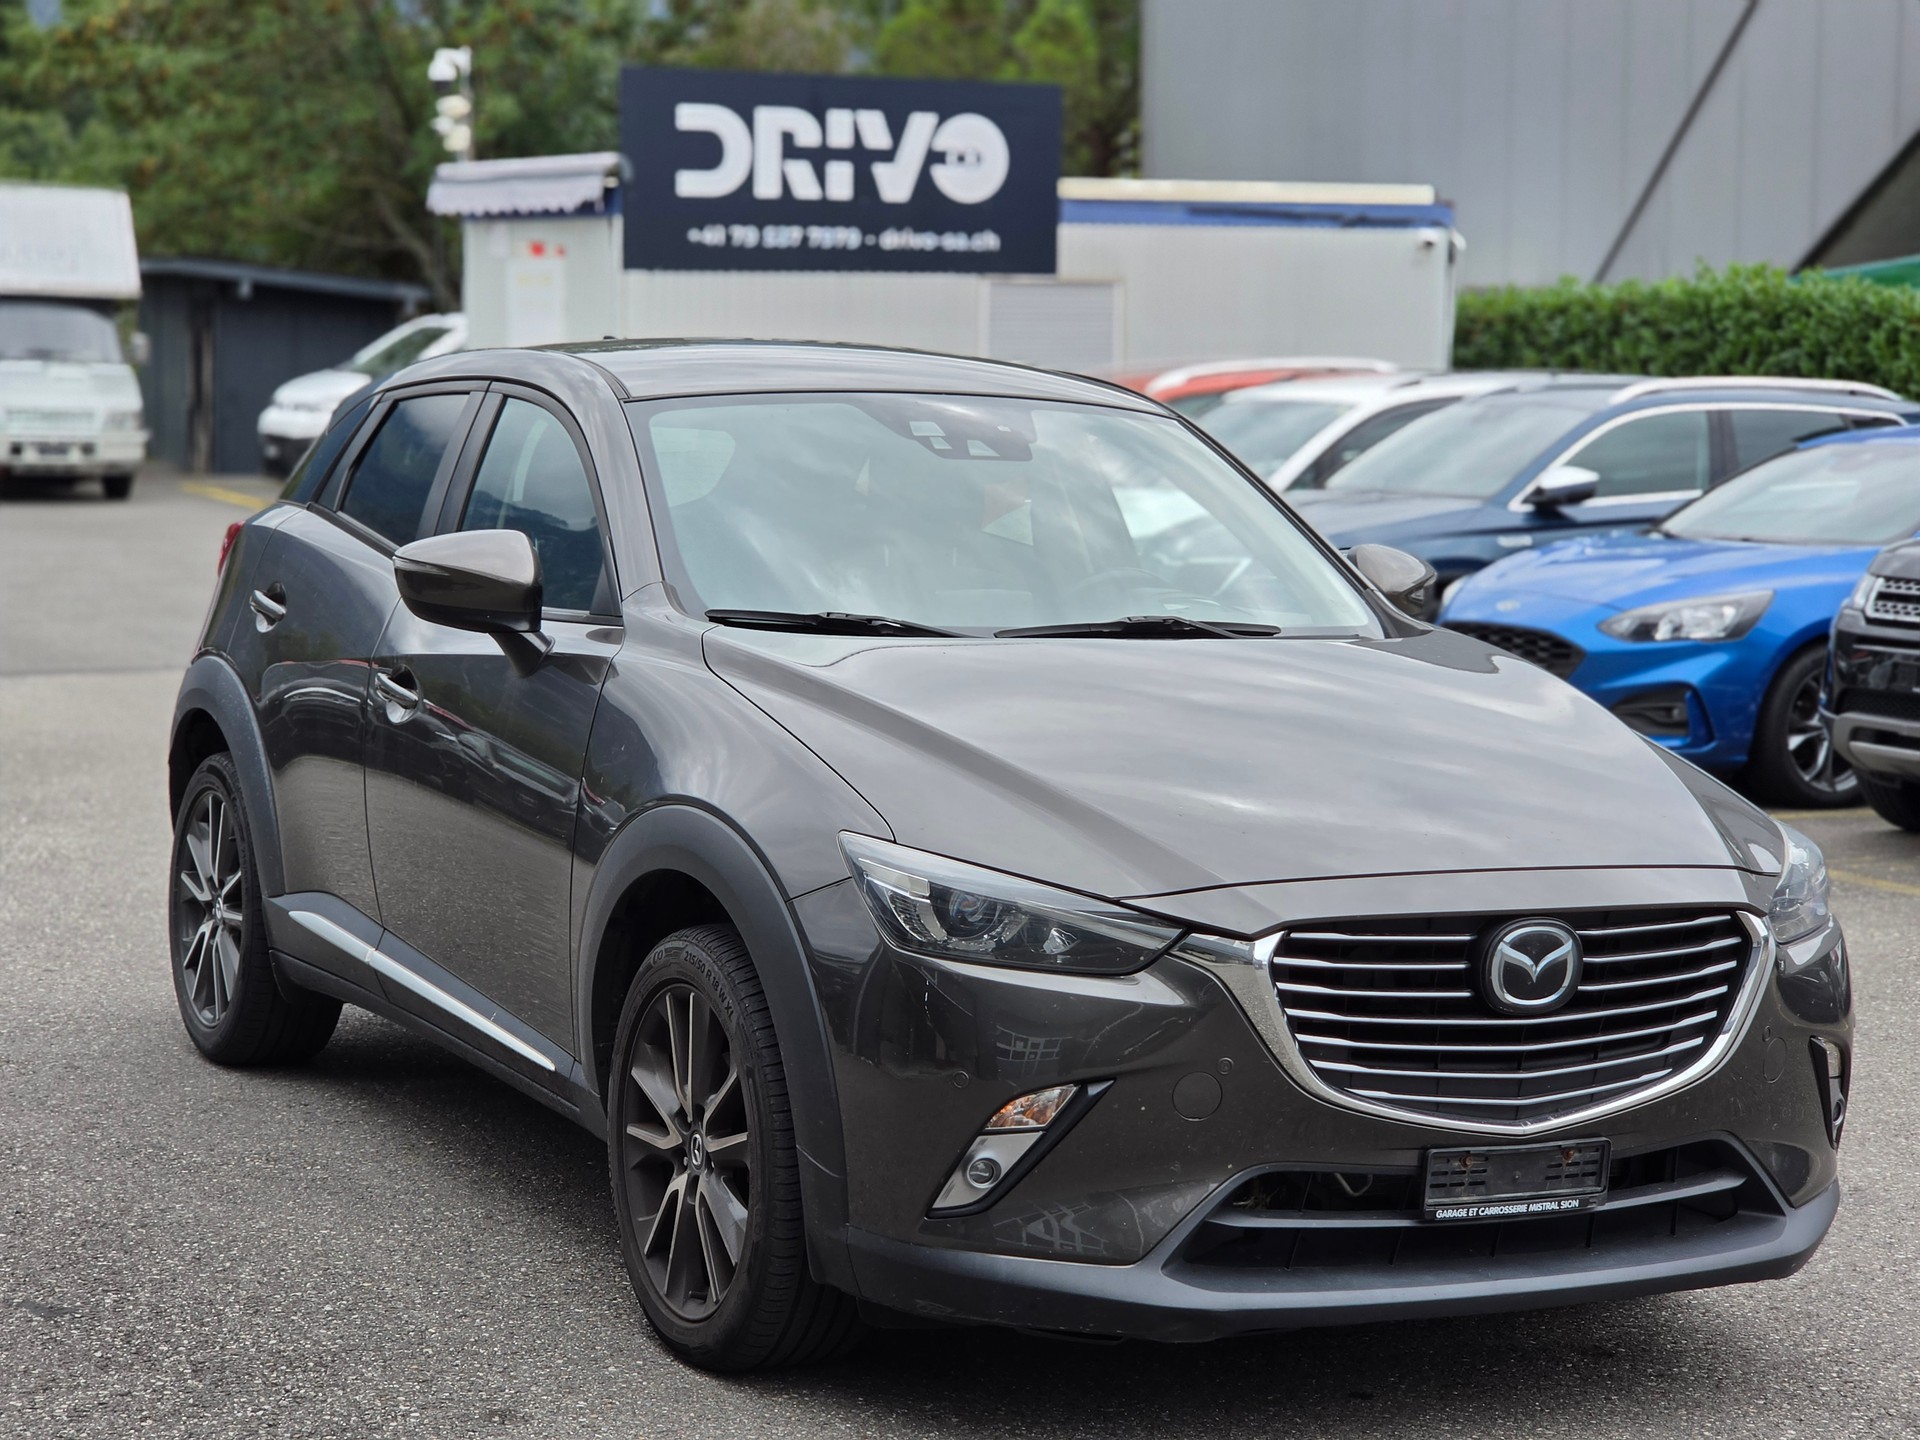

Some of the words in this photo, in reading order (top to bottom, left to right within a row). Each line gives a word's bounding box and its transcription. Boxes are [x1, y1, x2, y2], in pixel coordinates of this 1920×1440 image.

[674, 102, 1010, 204] DRIVO
[684, 950, 706, 974] 215/50
[1436, 1208, 1468, 1218] GARAGE
[1468, 1207, 1478, 1217] ET
[1479, 1203, 1528, 1216] CARROSSERIE
[1528, 1200, 1560, 1212] MISTRAL
[1560, 1199, 1579, 1208] SION
